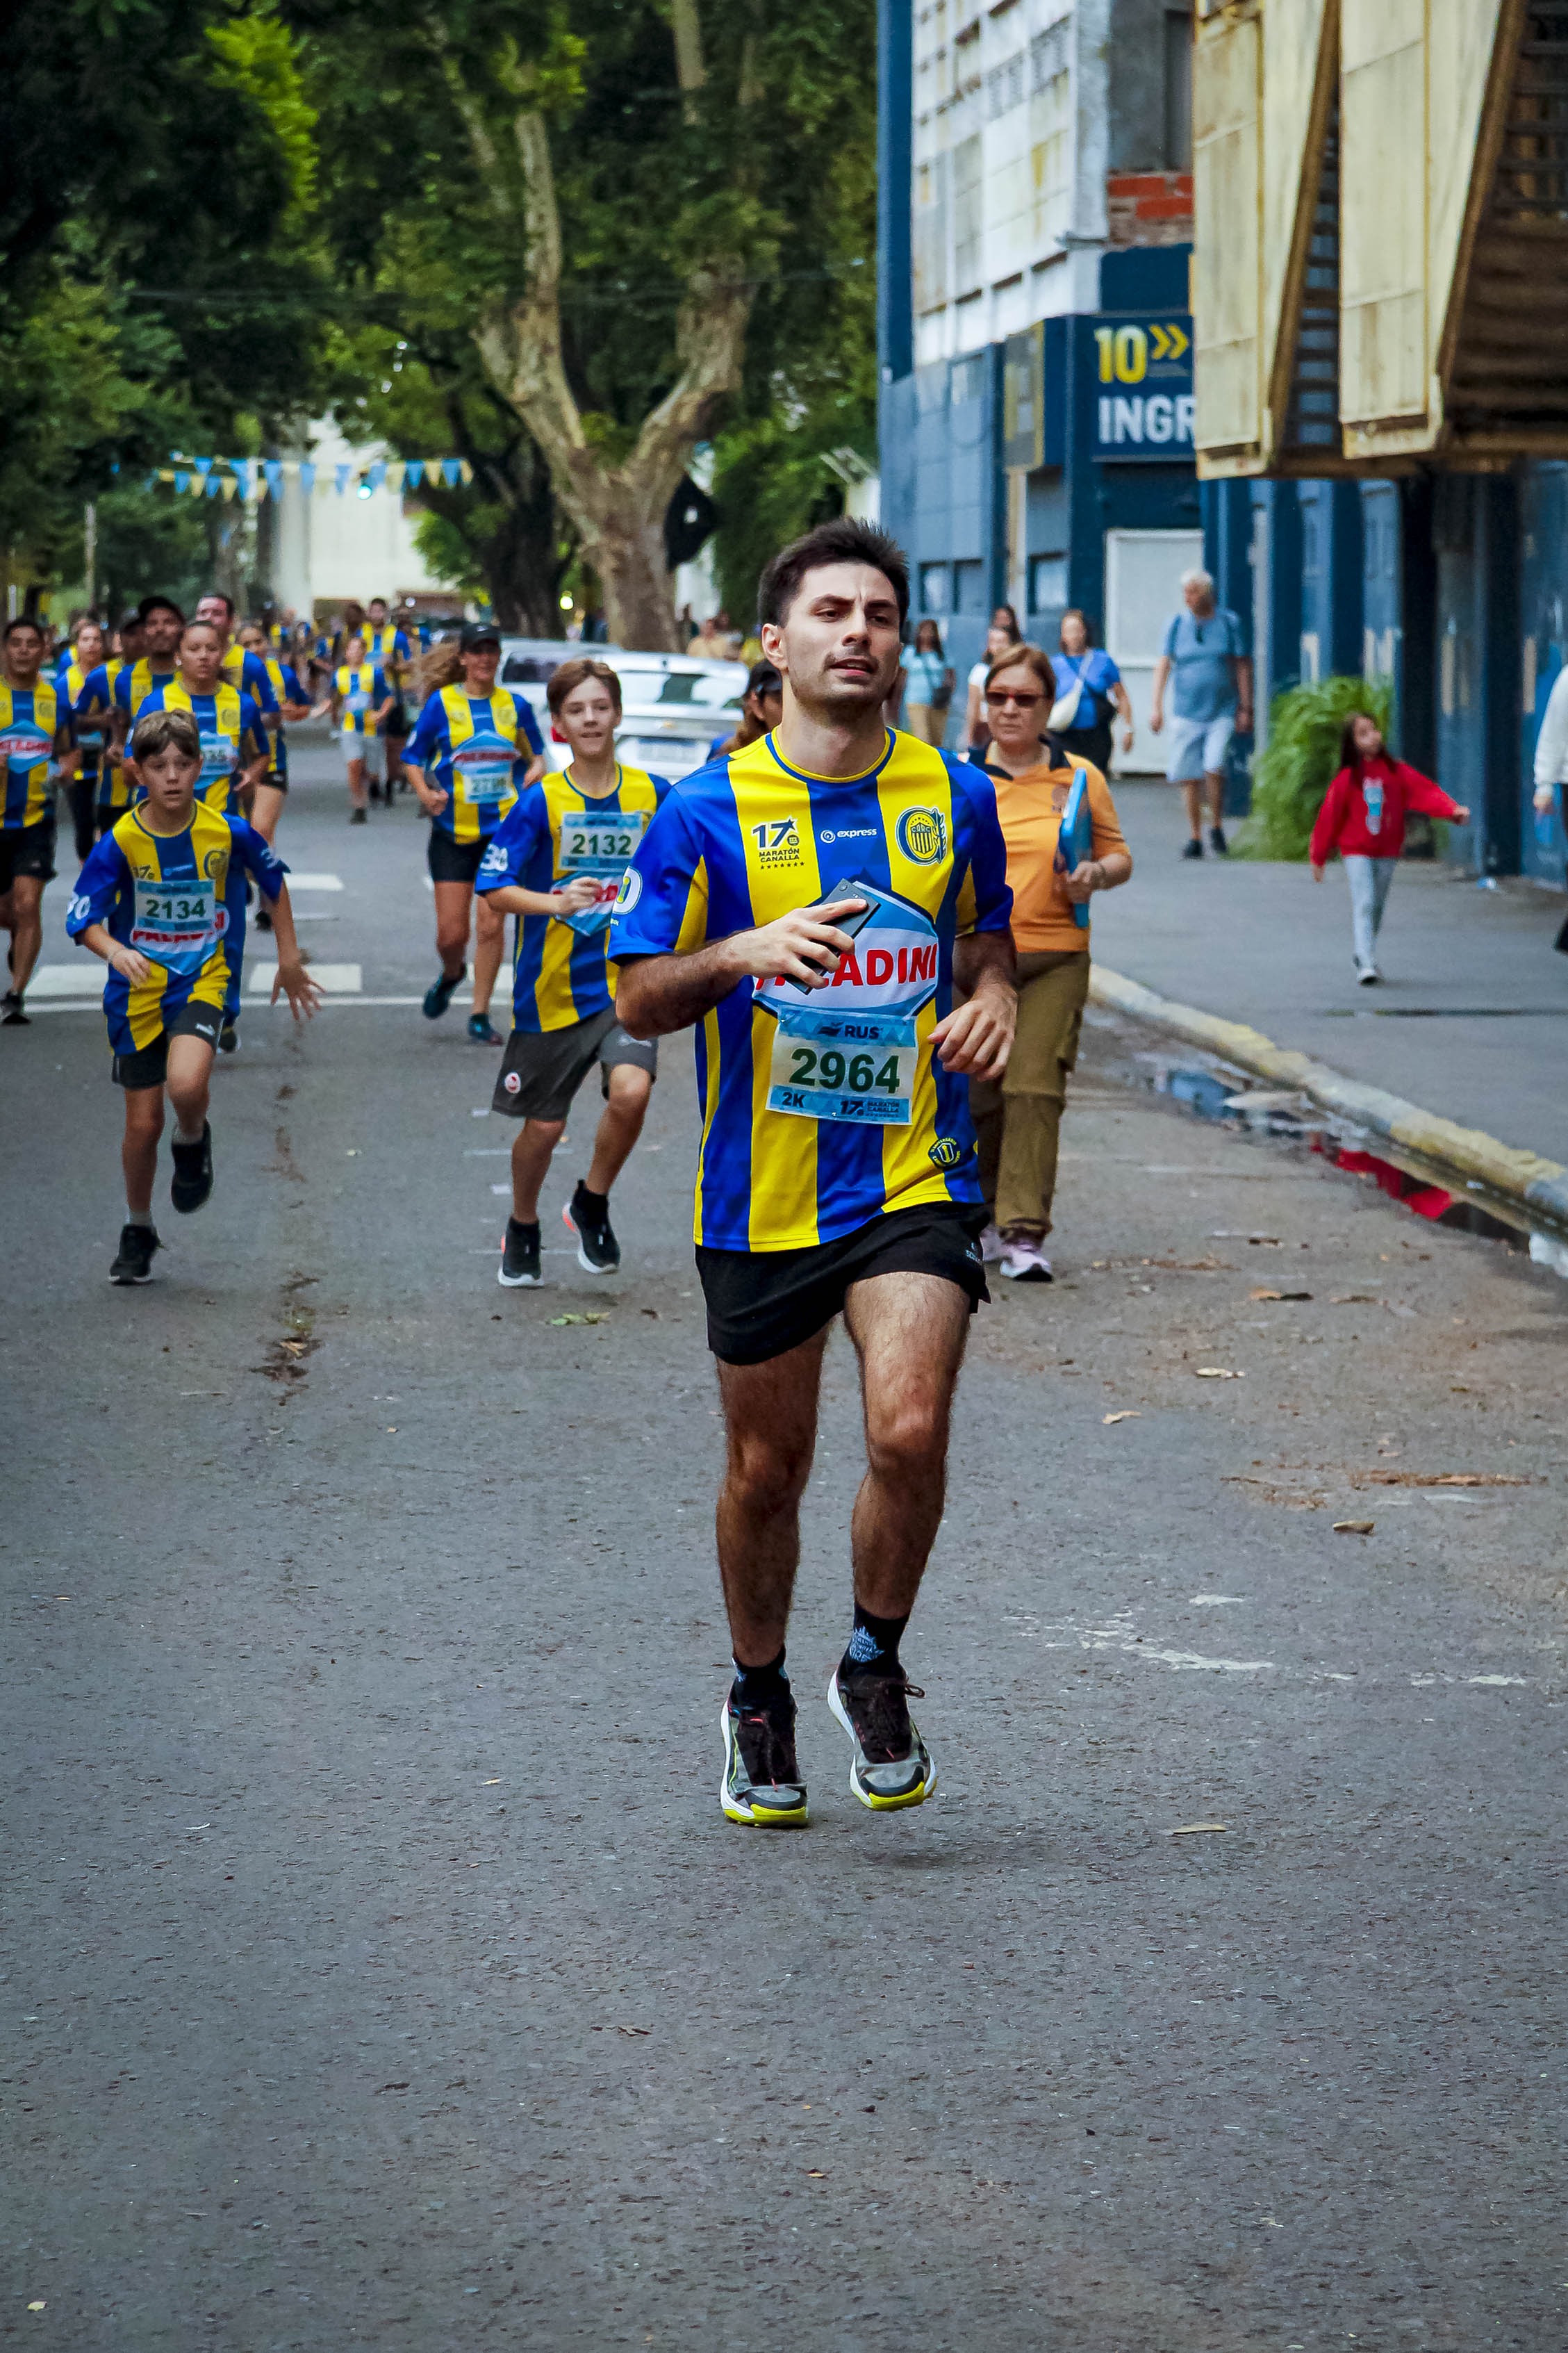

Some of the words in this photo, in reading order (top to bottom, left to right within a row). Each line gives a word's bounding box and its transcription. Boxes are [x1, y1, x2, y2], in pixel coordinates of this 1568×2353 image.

[1094, 325, 1147, 384] 10
[1098, 394, 1196, 443] INGR
[837, 828, 877, 838] express
[570, 833, 632, 855] 2132
[759, 847, 800, 857] MARATÓN
[145, 899, 206, 919] 2134
[756, 943, 938, 990] ADINI
[844, 1024, 880, 1040] RUS
[789, 1048, 900, 1094] 2964
[782, 1092, 806, 1108] 2K
